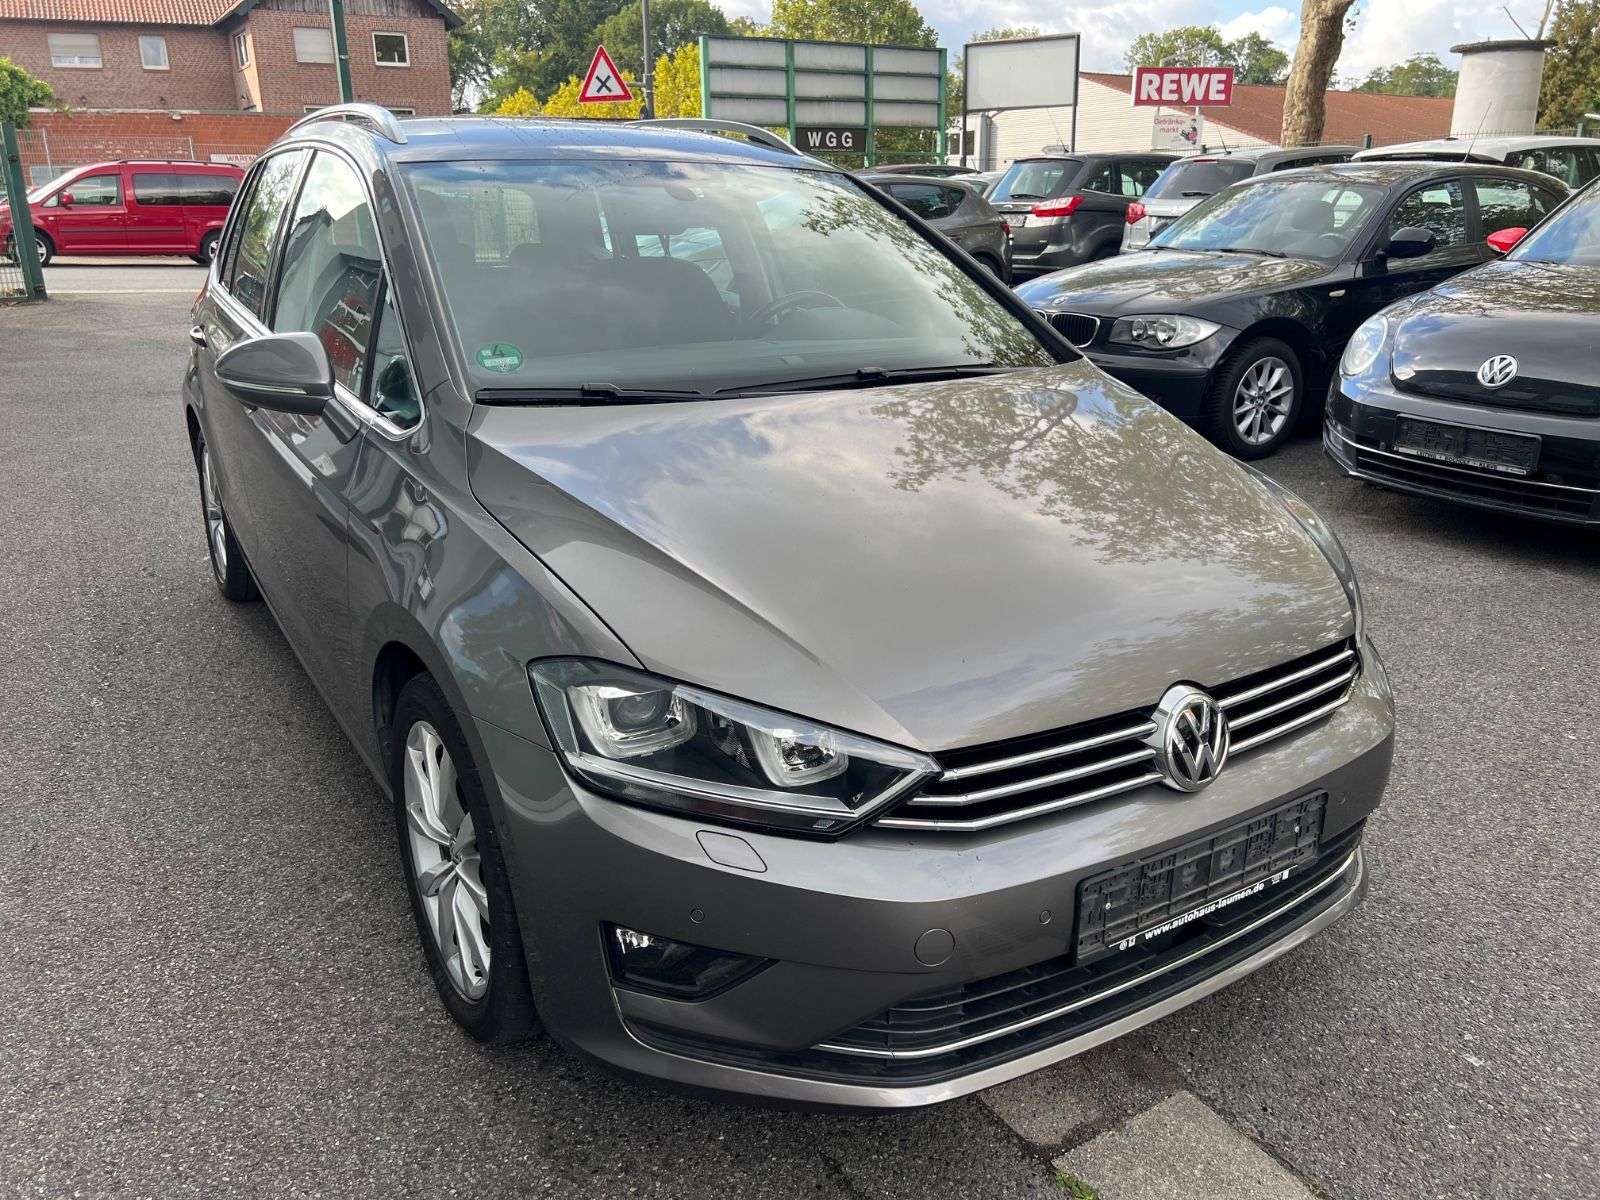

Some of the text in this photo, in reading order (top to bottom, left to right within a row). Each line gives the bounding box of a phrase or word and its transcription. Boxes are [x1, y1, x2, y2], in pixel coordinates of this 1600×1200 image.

[1140, 73, 1226, 102] REWE
[1477, 355, 1518, 388] VW
[1165, 691, 1229, 791] VW
[1144, 882, 1265, 940] www.autohaus-laumen.de
